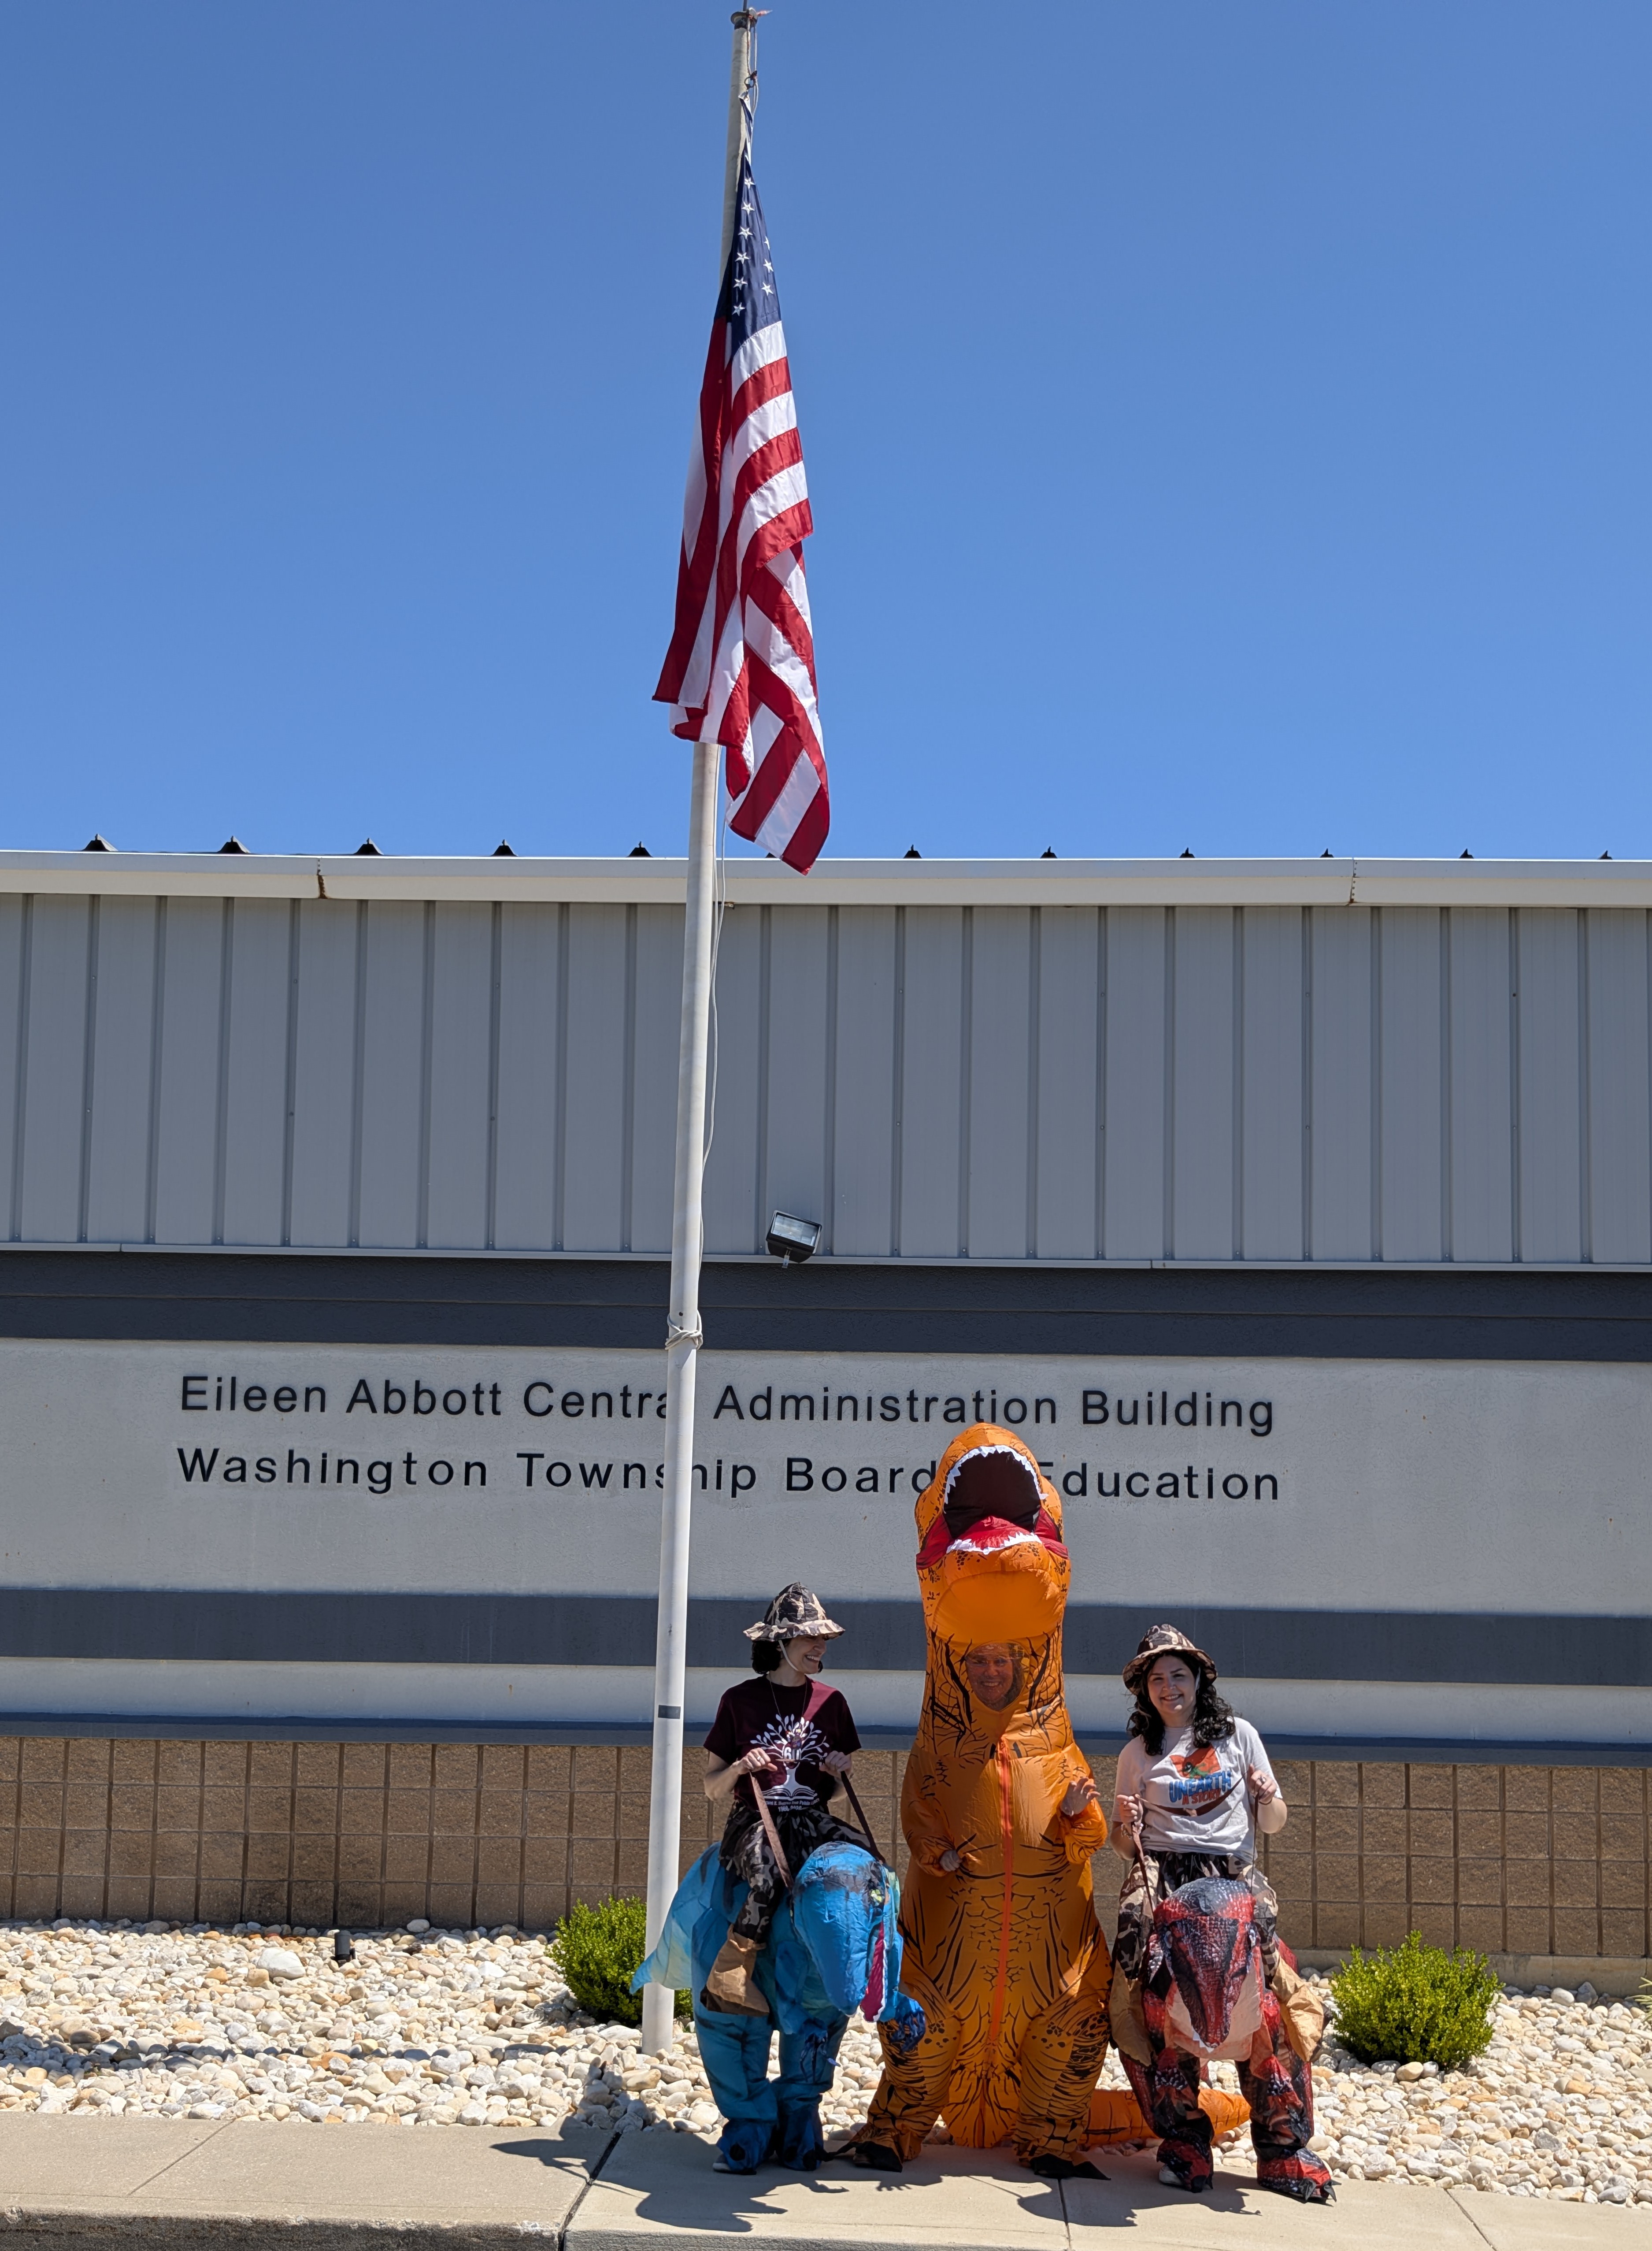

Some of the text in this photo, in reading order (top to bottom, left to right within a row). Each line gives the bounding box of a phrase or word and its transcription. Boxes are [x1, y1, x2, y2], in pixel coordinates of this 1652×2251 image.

[181, 1376, 1273, 1437] Eileen Abbott Centr Administration Building
[177, 1448, 487, 1494] Washington
[786, 1457, 936, 1494] Board
[1169, 1770, 1231, 1803] UNEARTH
[1182, 1788, 1222, 1805] A STORY
